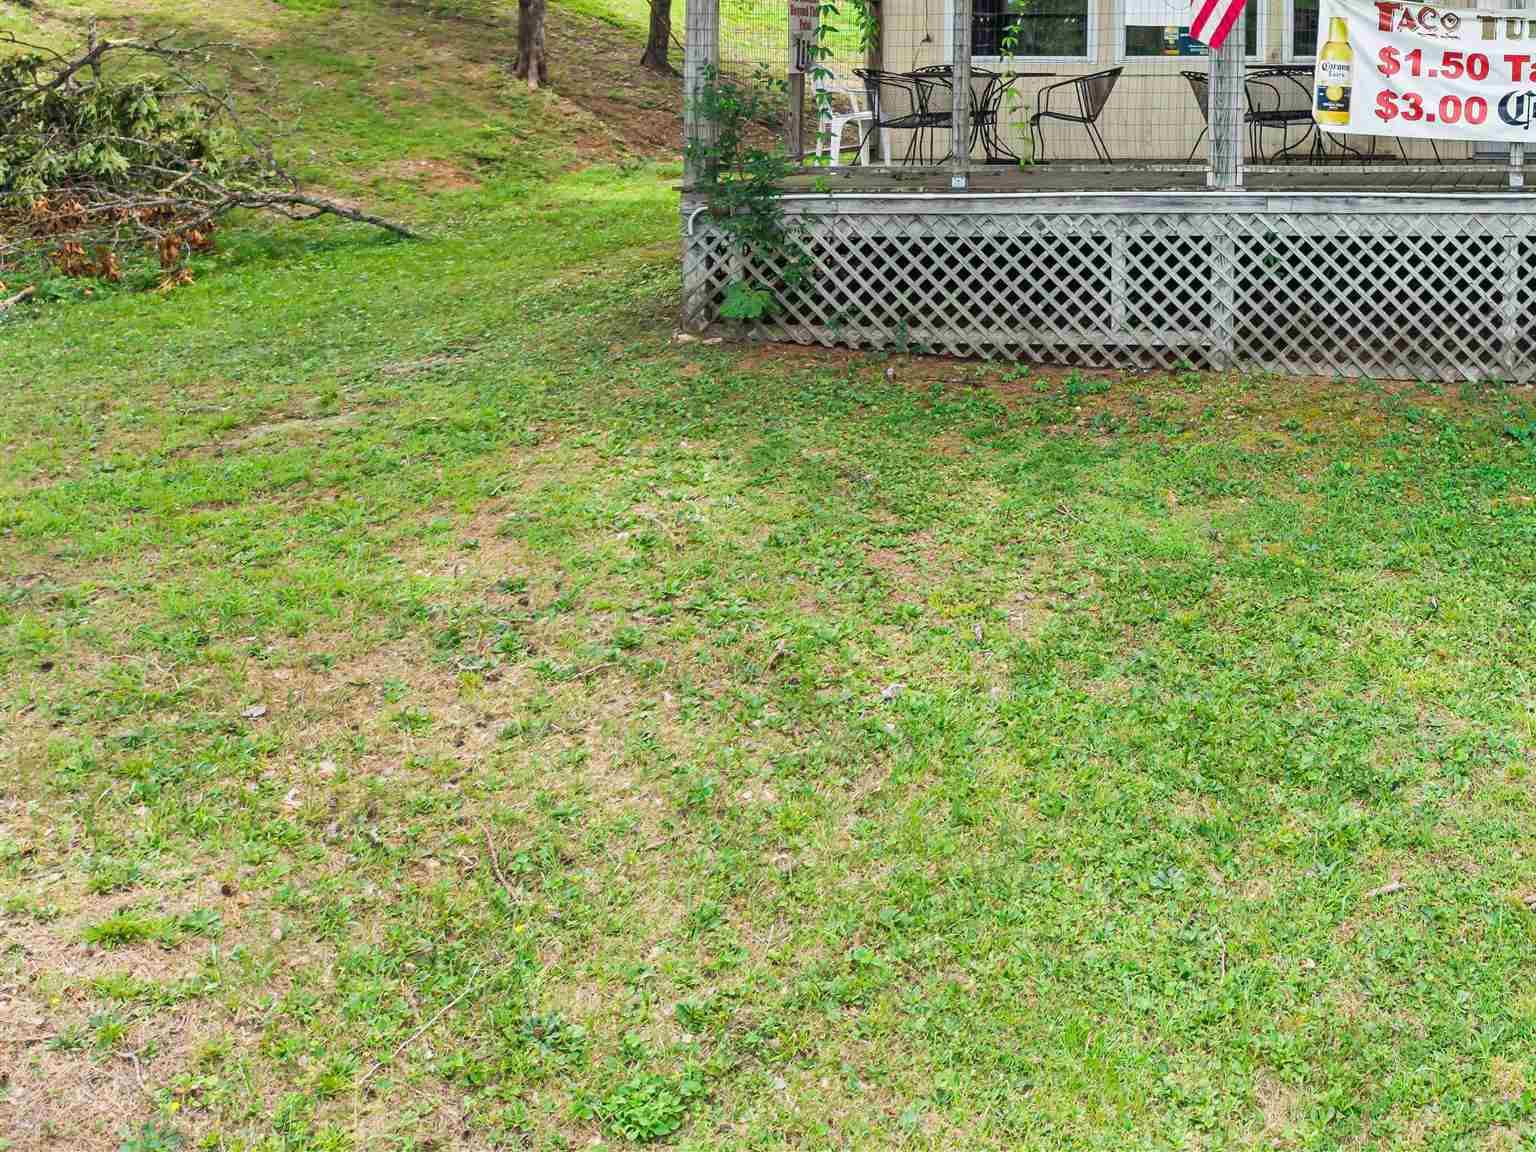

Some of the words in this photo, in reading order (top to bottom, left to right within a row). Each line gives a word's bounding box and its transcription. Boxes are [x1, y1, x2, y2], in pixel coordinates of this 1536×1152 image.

[1375, 1, 1461, 38] TACO
[1376, 46, 1490, 82] $1.50
[1374, 88, 1488, 124] $3.00
